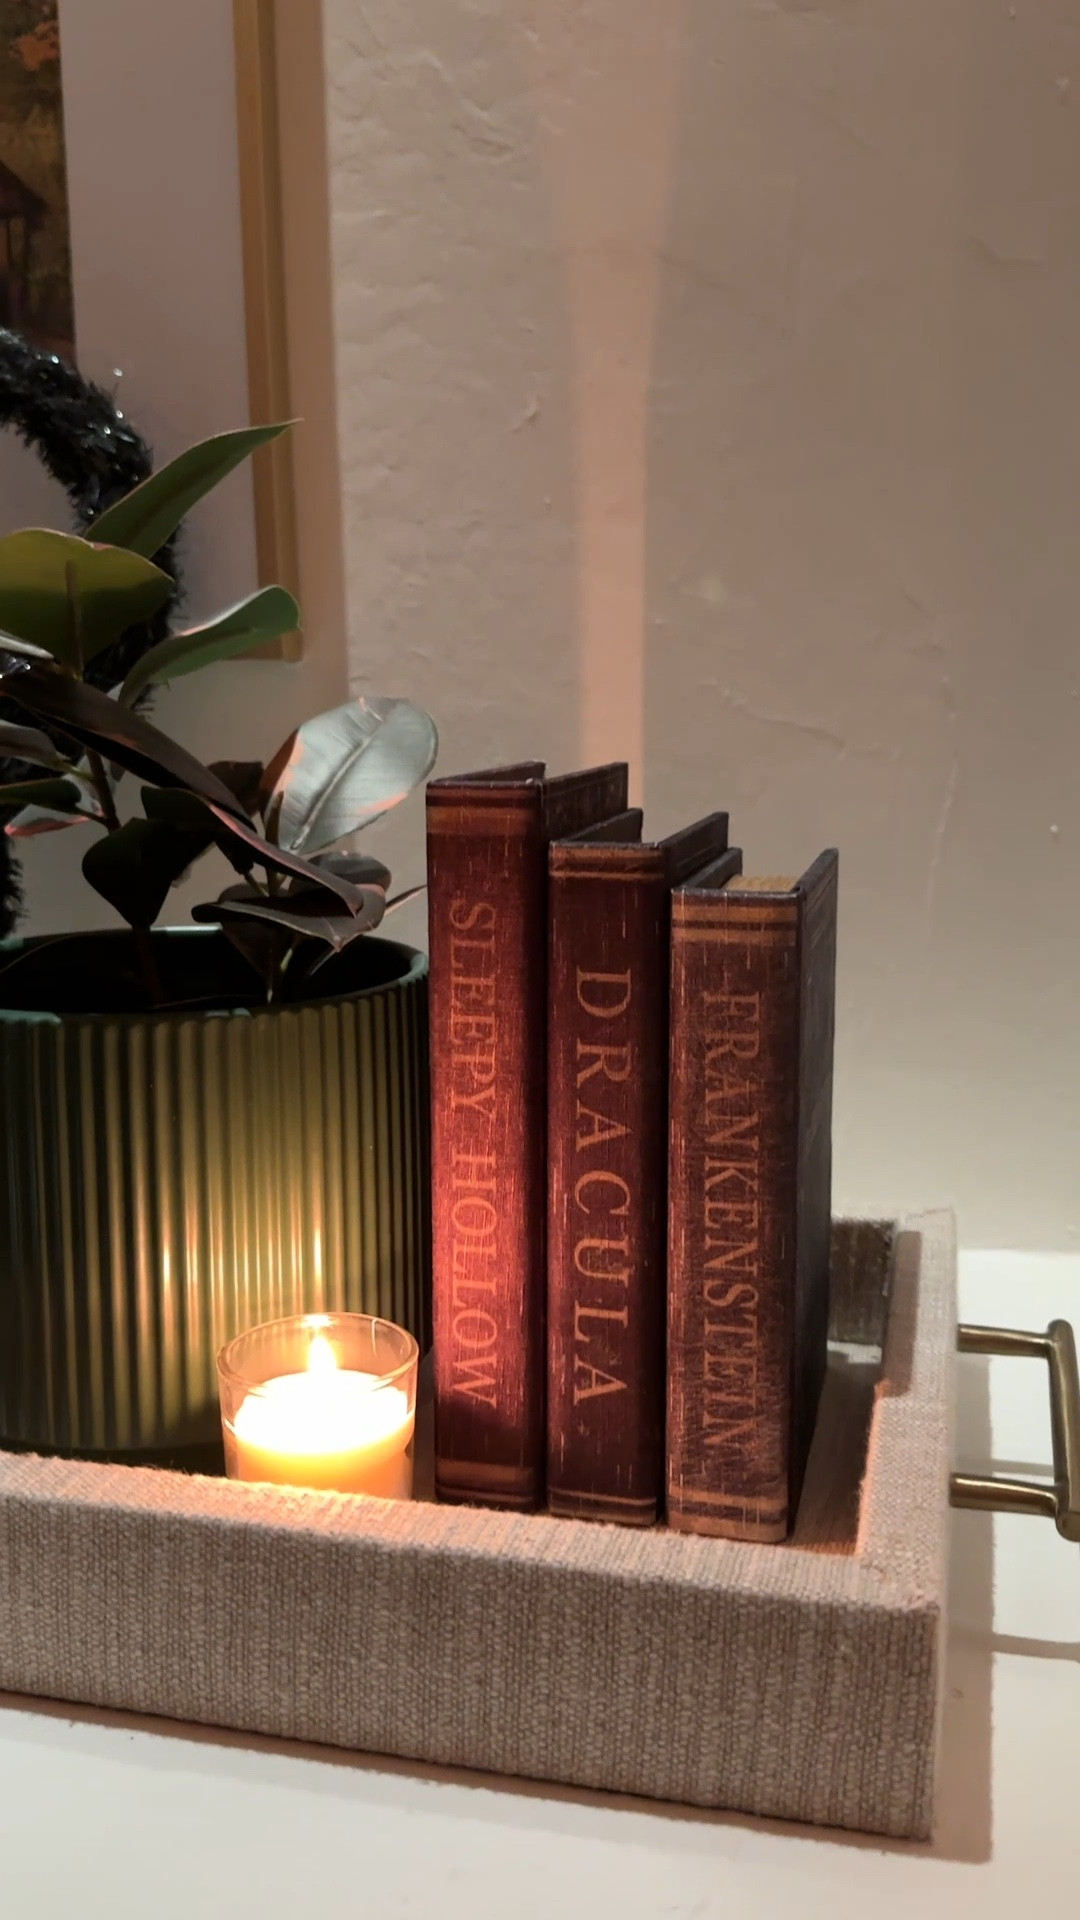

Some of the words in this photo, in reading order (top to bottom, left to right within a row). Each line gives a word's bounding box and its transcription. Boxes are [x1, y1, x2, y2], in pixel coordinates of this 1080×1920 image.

[449, 901, 498, 1118] SLEEPY
[451, 1150, 498, 1409] HOLLOW
[574, 967, 633, 1406] DRACULA
[702, 991, 761, 1449] FRANKENSTEIN
